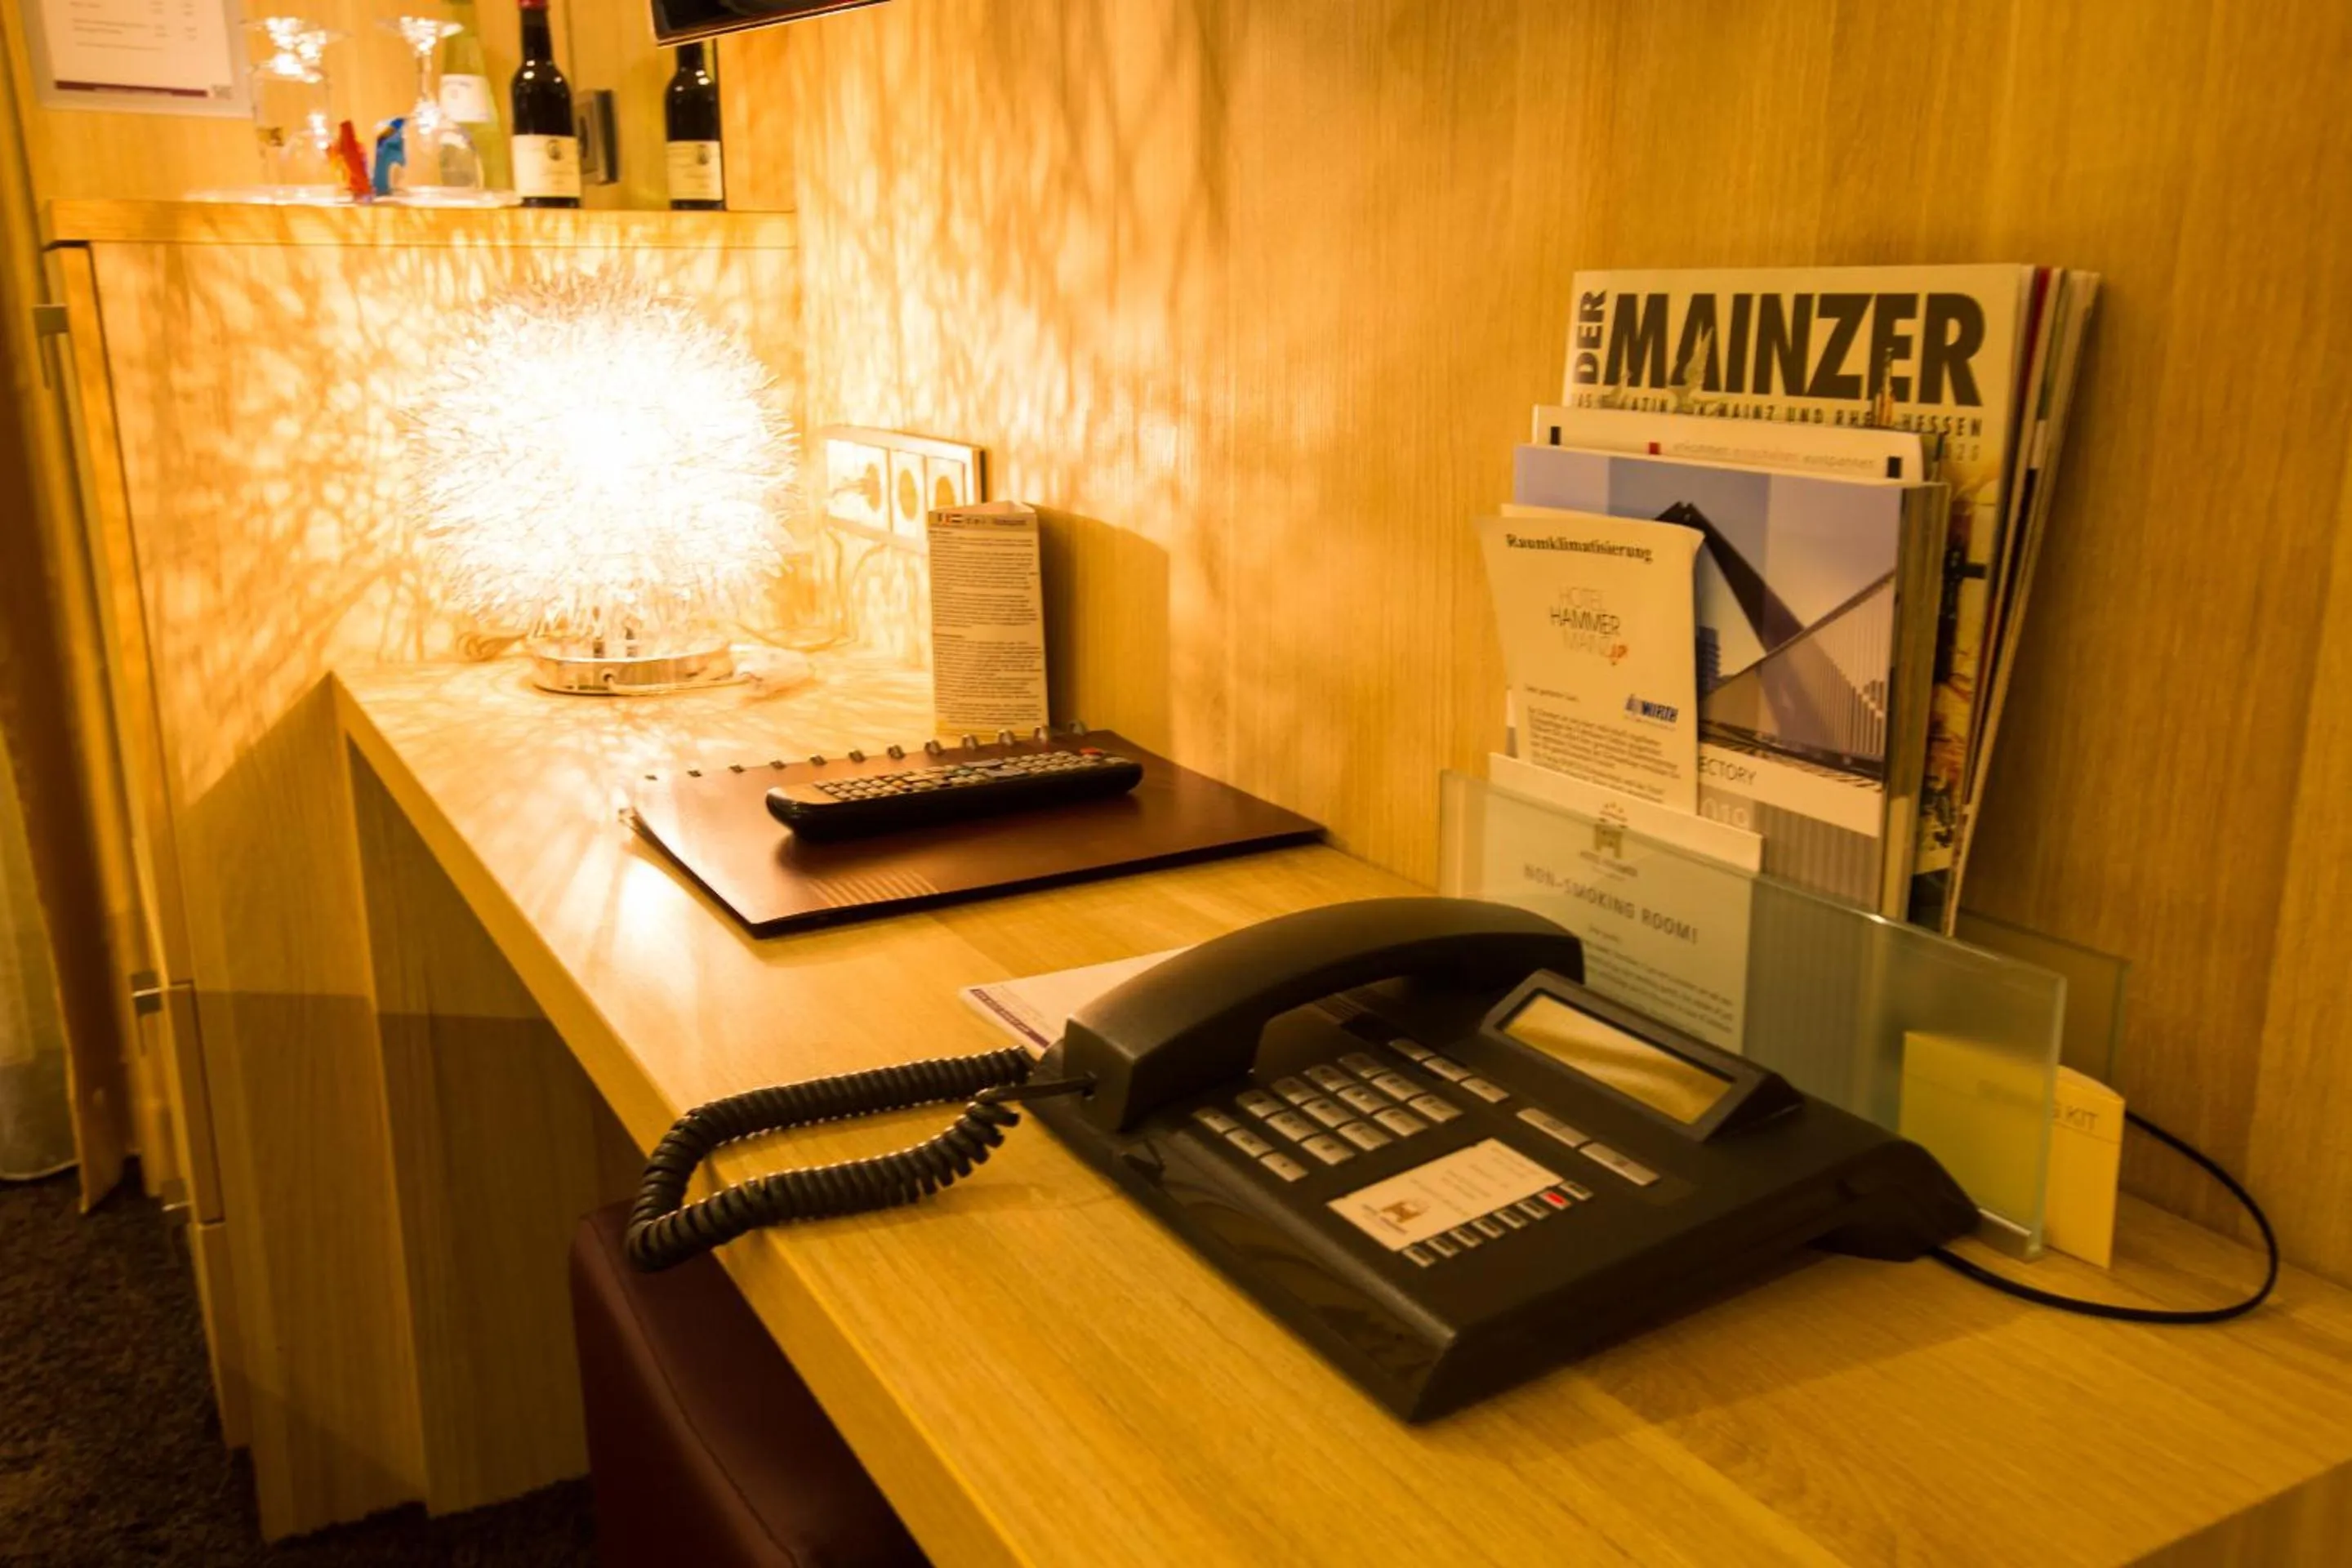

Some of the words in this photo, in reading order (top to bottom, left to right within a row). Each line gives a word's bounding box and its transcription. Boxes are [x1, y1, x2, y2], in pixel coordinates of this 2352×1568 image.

[1574, 289, 1606, 385] DER
[1603, 292, 1986, 407] MAINZER
[1784, 405, 1825, 424] UND
[1835, 408, 1983, 438] RHEHESSEN
[1506, 533, 1654, 564] Raumklimatisierung
[1549, 604, 1621, 637] HAMMER
[1523, 862, 1635, 920] NON-SMOKING
[1642, 906, 1699, 945] ROOM!
[2065, 1105, 2099, 1131] KIT
